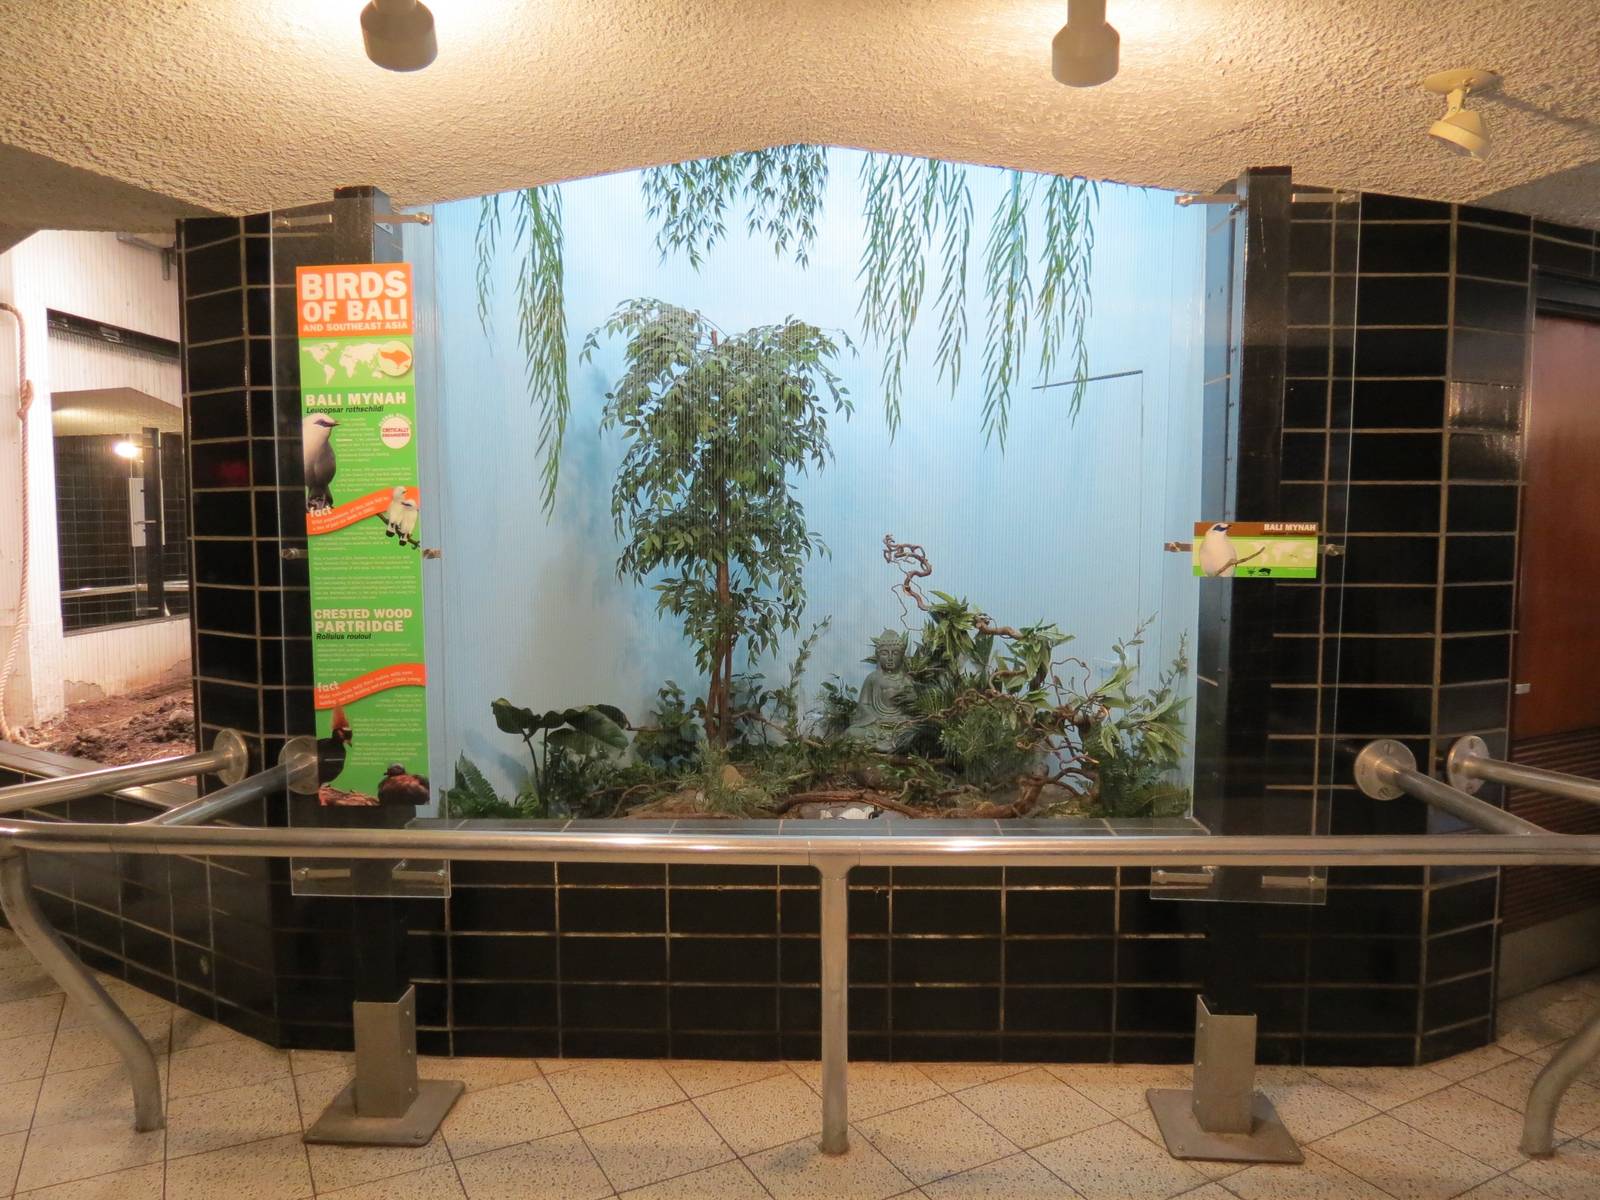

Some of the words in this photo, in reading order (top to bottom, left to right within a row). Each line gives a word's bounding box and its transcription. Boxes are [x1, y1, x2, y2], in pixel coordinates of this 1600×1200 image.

[301, 270, 407, 300] BIRDS
[303, 301, 337, 323] OF
[346, 299, 408, 321] BALI
[303, 324, 324, 332] AND
[326, 322, 381, 331] SOUTHEAST
[384, 321, 408, 330] ASIA
[305, 394, 342, 406] BALI
[347, 392, 406, 405] MYNAH
[345, 405, 384, 413] rothschildi
[310, 506, 332, 517] fact
[1264, 523, 1283, 531] BALI
[1285, 523, 1316, 531] MYNAH
[314, 609, 370, 619] CRESTED
[374, 608, 413, 618] WOOD
[315, 620, 404, 633] PARTRIDGE
[318, 681, 338, 692] fact
